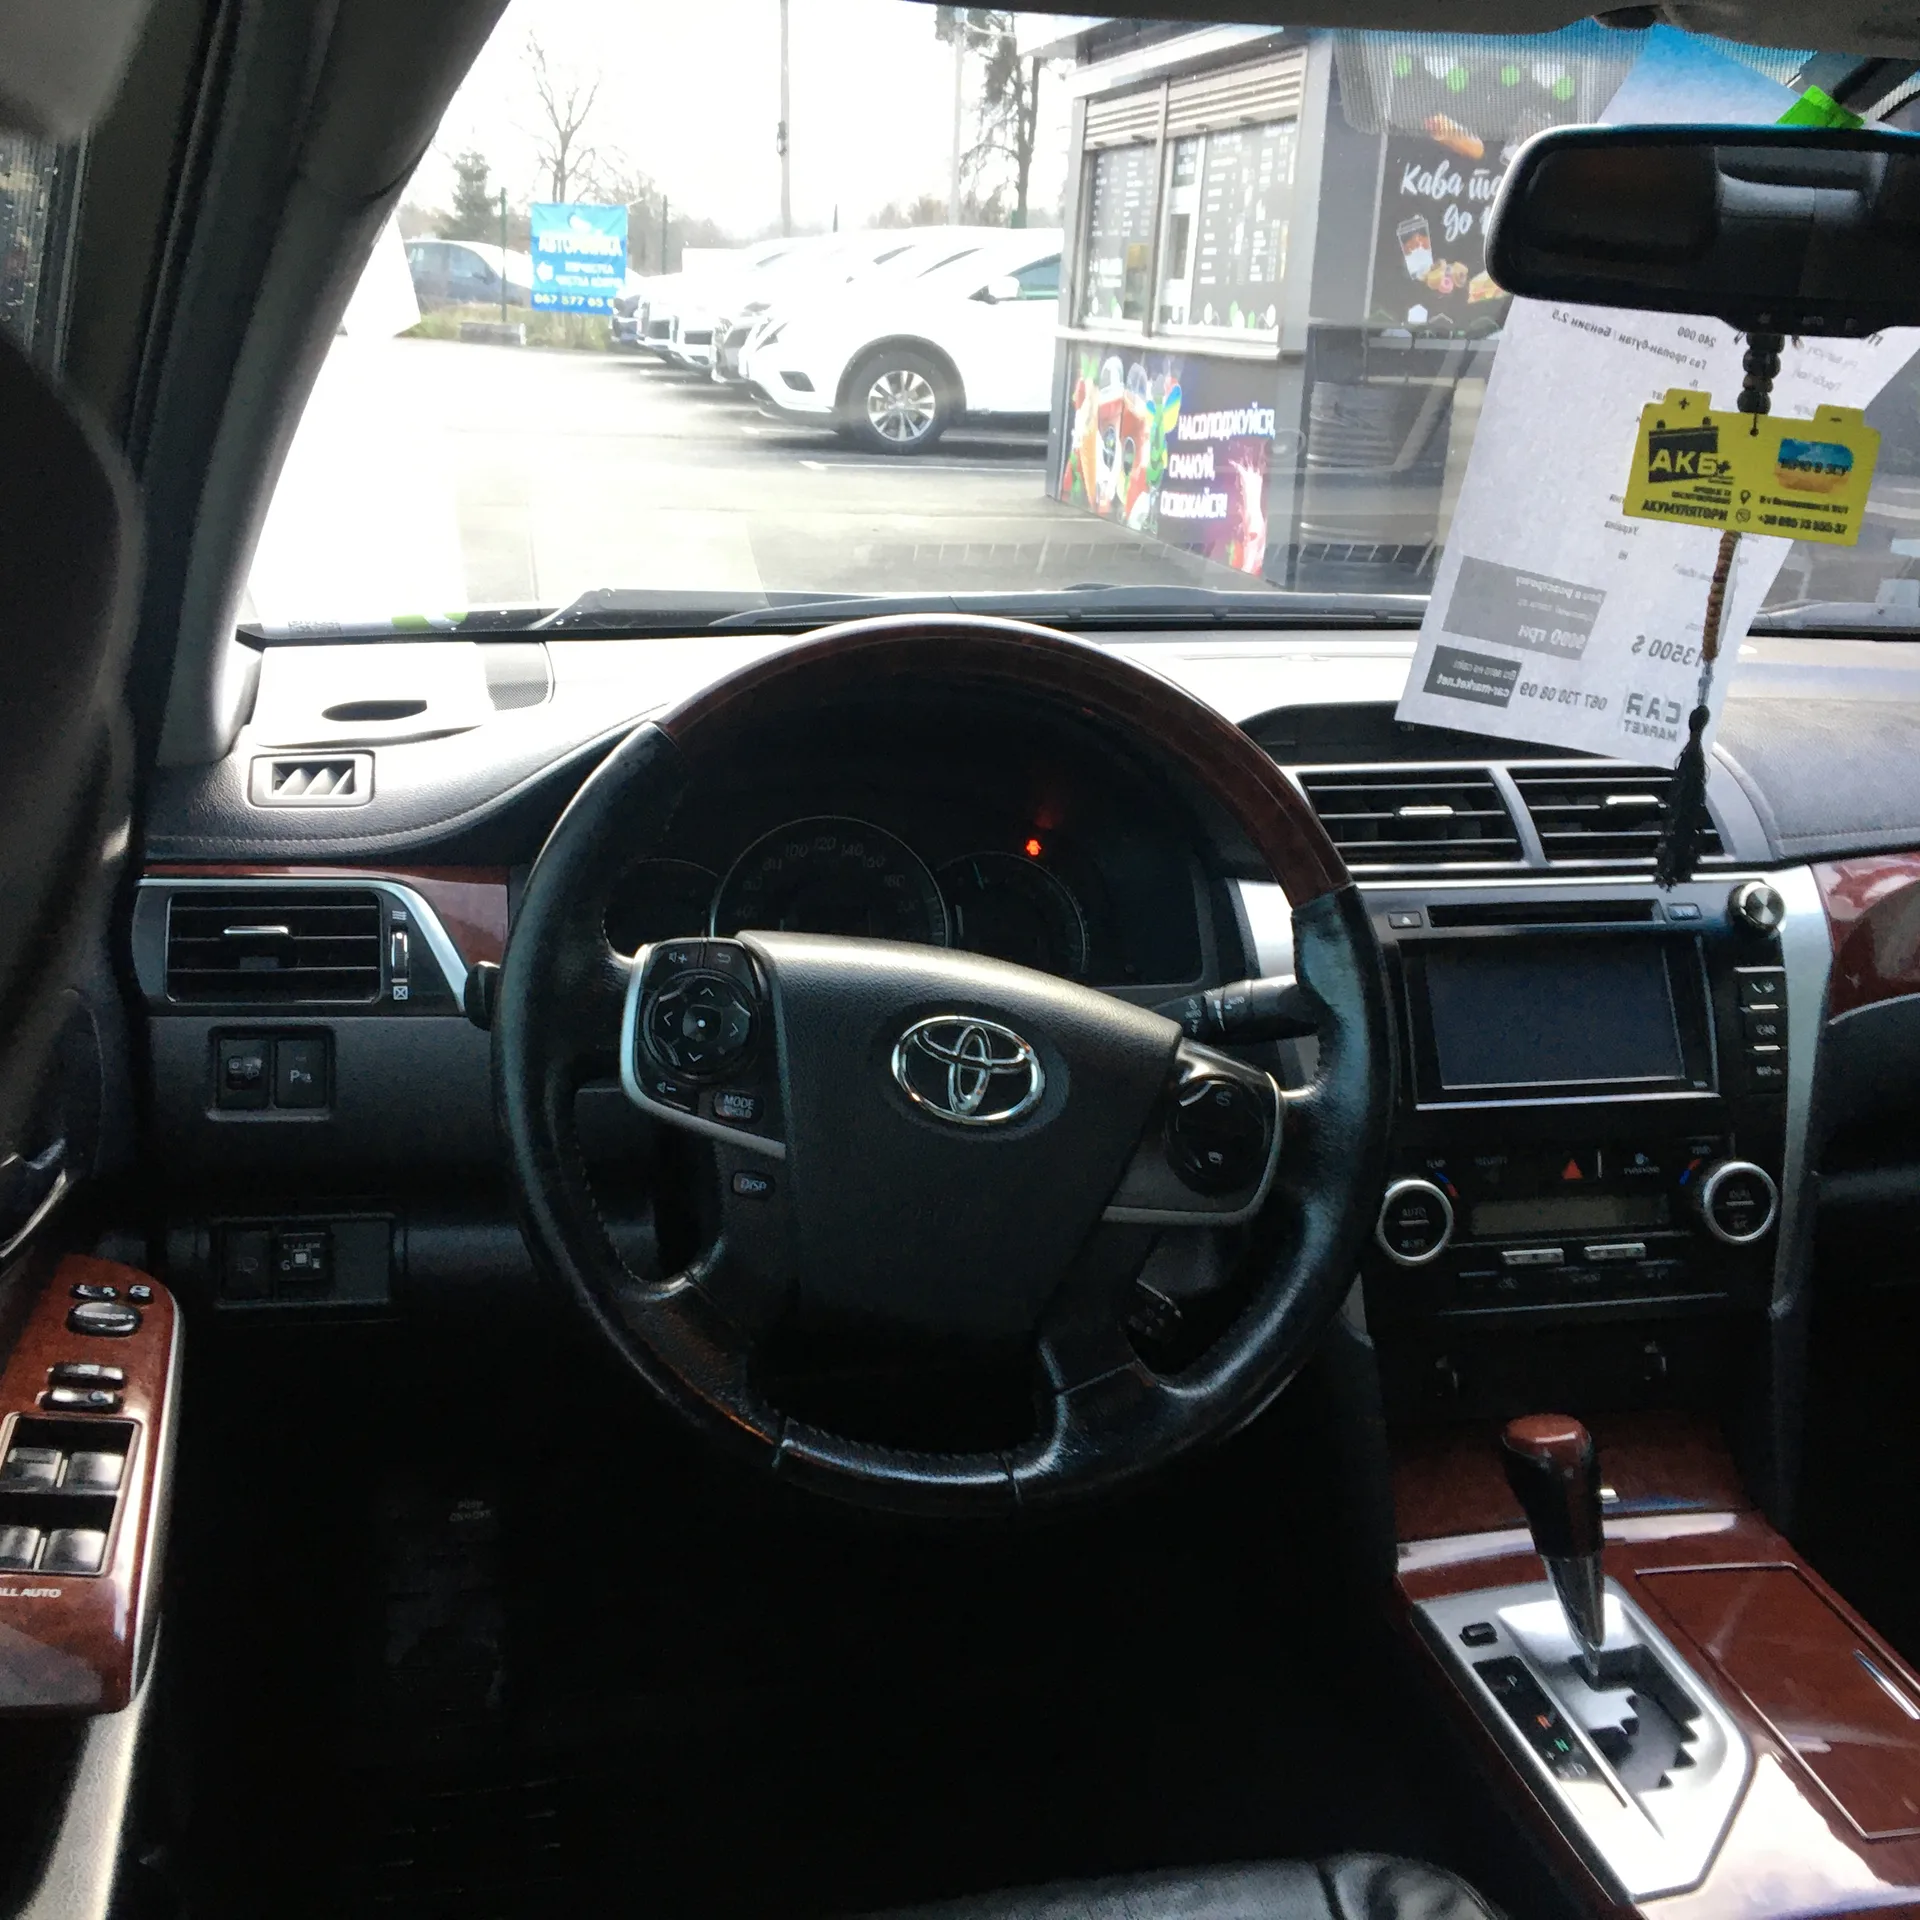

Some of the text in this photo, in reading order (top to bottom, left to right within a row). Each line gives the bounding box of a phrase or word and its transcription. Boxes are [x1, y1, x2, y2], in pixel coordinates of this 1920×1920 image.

[1400, 159, 1463, 200] Кава
[1443, 203, 1473, 242] до
[723, 1094, 755, 1110] MODE
[20, 1588, 61, 1598] AUTO
